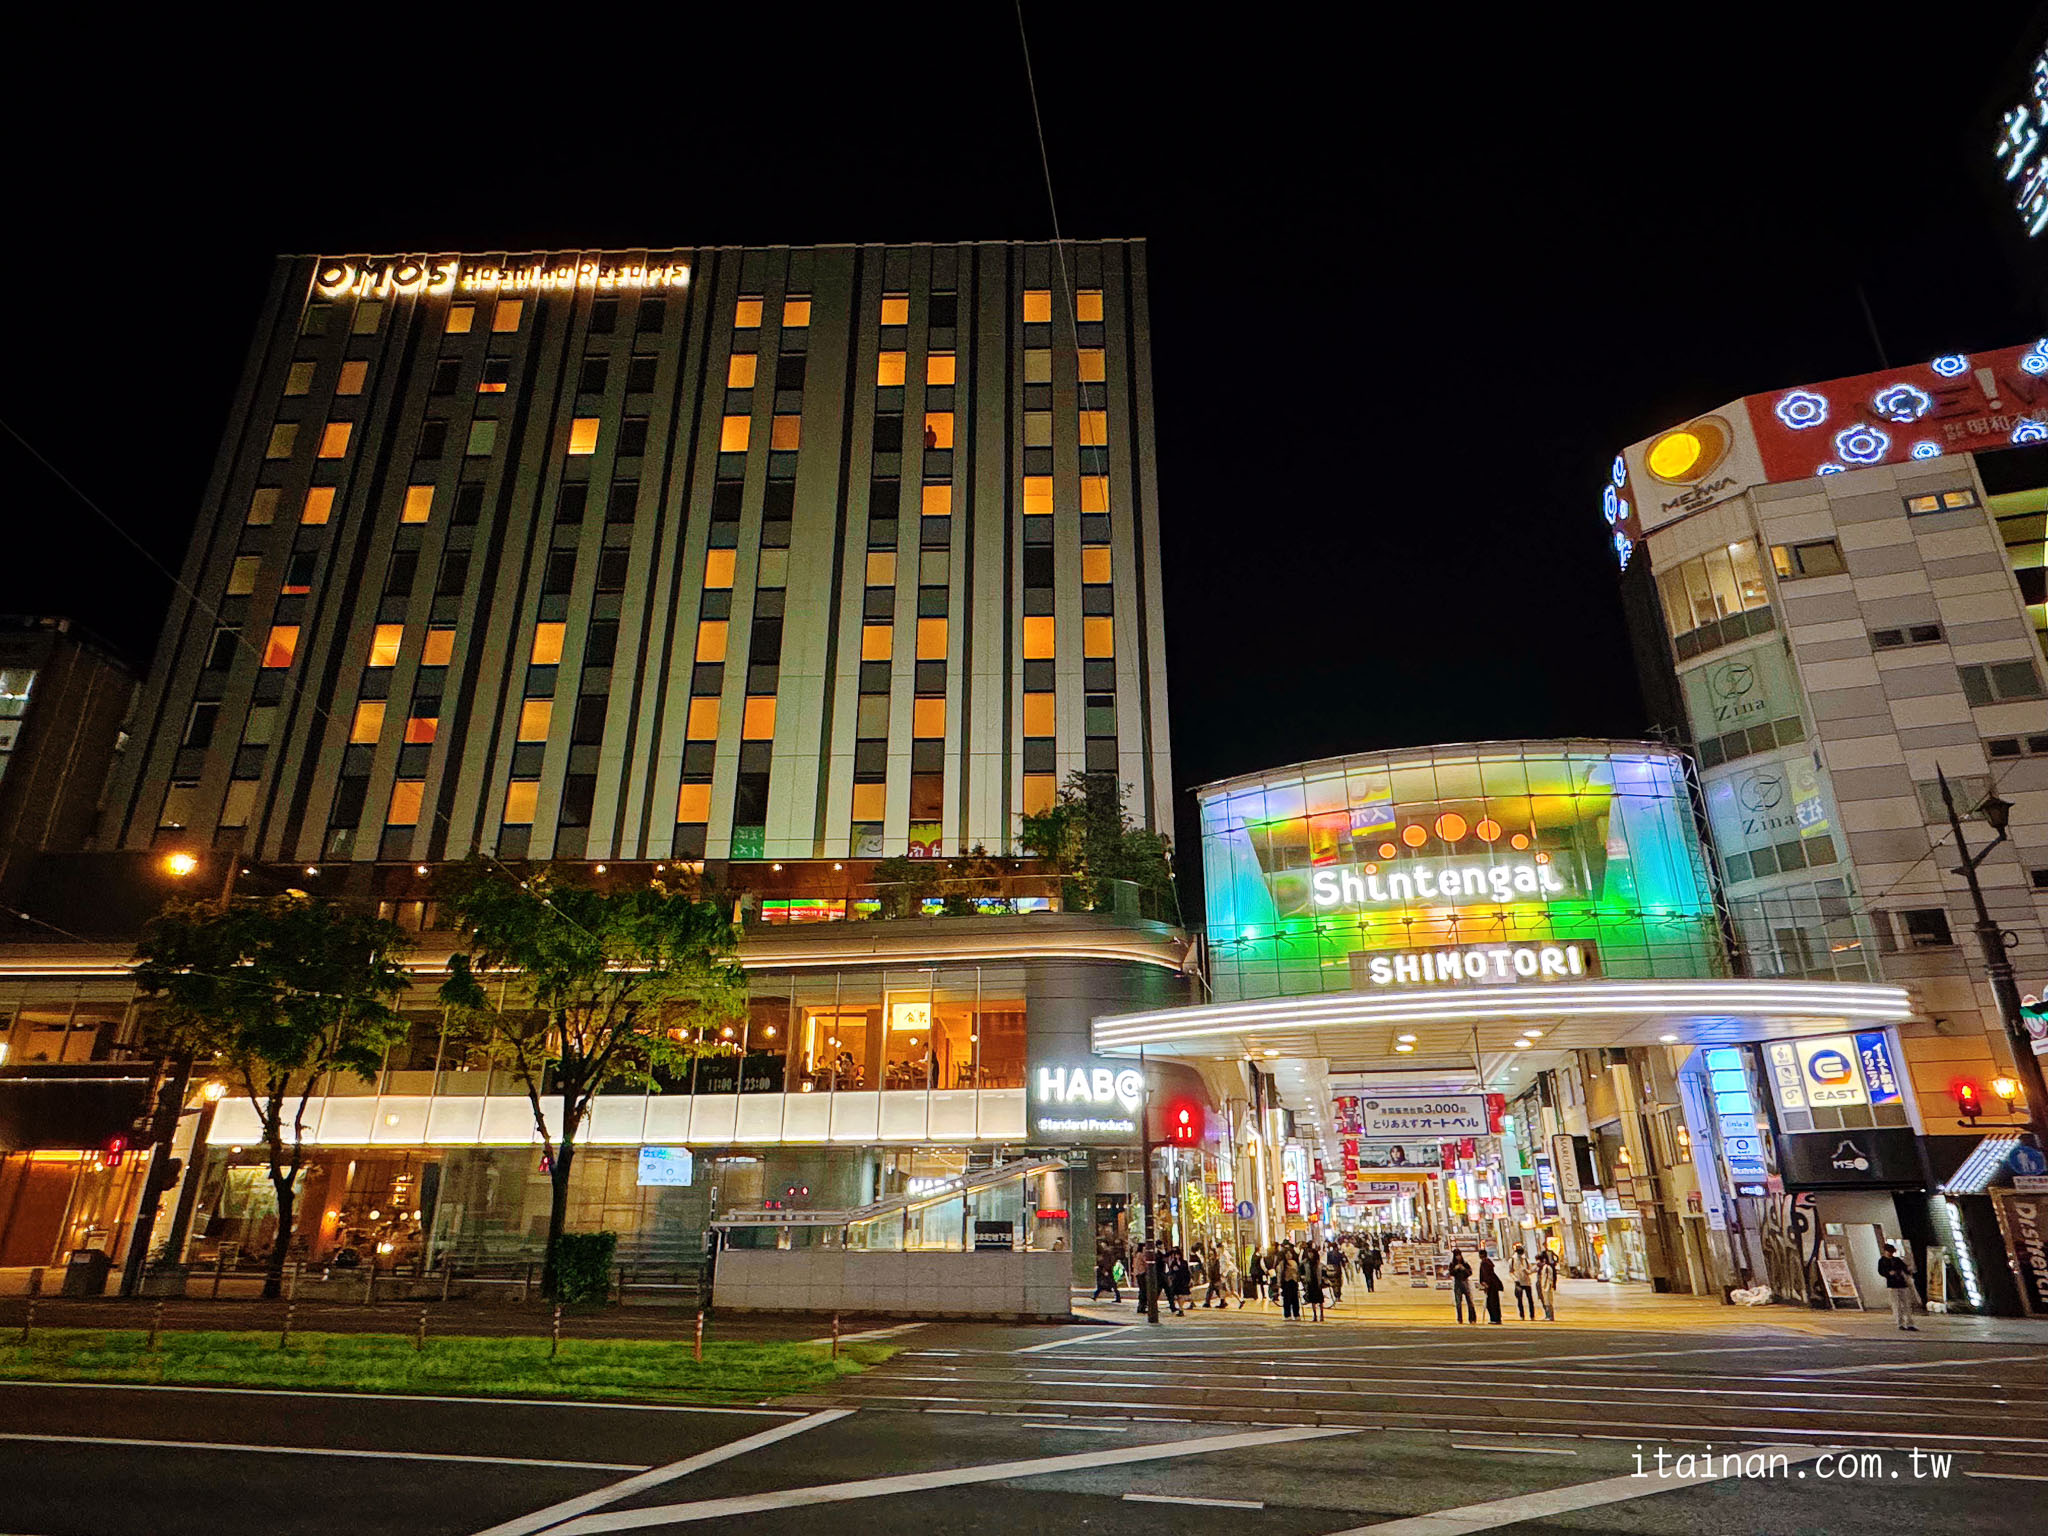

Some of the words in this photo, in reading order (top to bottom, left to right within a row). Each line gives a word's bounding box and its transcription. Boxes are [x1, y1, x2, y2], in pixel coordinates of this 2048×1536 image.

[1716, 700, 1765, 721] Zina
[1743, 815, 1795, 835] Zina
[1312, 863, 1563, 906] Shintengai
[1369, 945, 1584, 985] SHIMOTORI
[1814, 1089, 1858, 1101] EAST
[1039, 1119, 1088, 1131] Standard
[1089, 1119, 1135, 1132] Products
